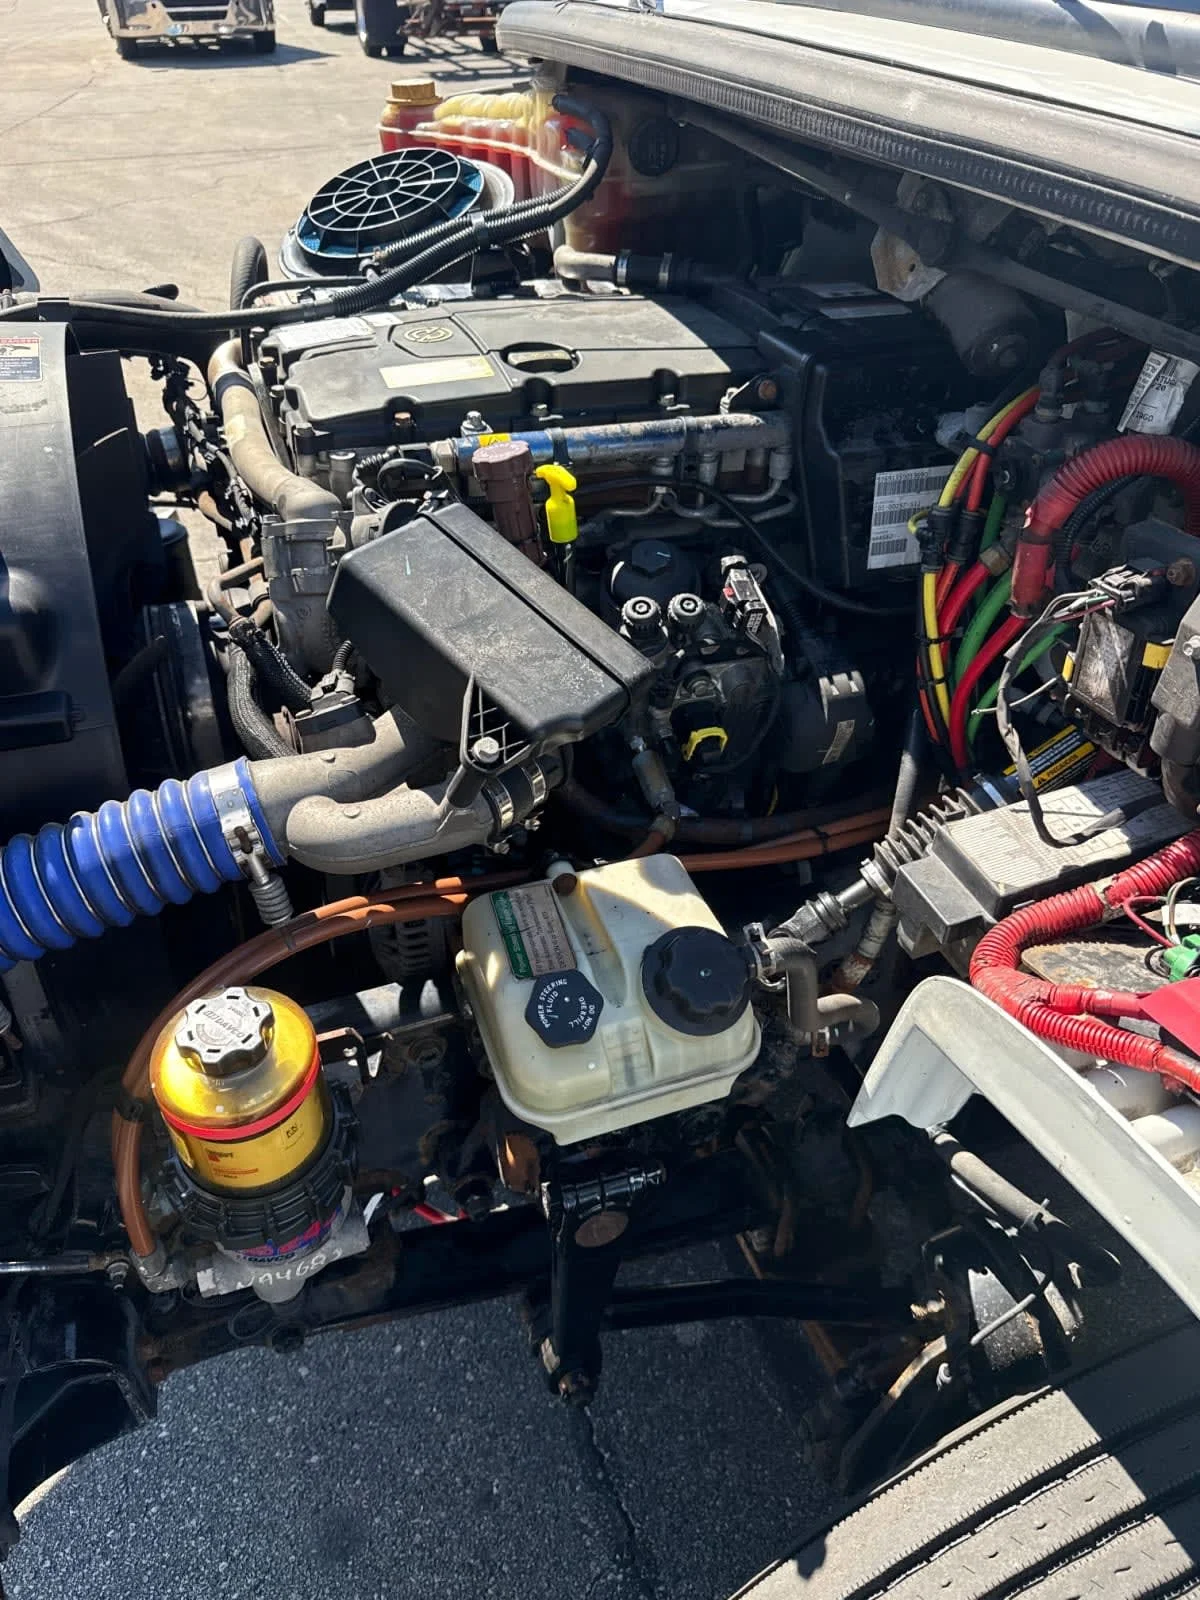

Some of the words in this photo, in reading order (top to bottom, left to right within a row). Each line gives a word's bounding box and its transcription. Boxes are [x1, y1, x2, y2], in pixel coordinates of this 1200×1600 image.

[539, 978, 568, 1001] STEERING
[545, 990, 559, 1014] FLUID
[568, 996, 588, 1028] OVERFILL
[588, 1004, 596, 1015] DO
[537, 1004, 551, 1029] POWER
[582, 1016, 593, 1031] NOT
